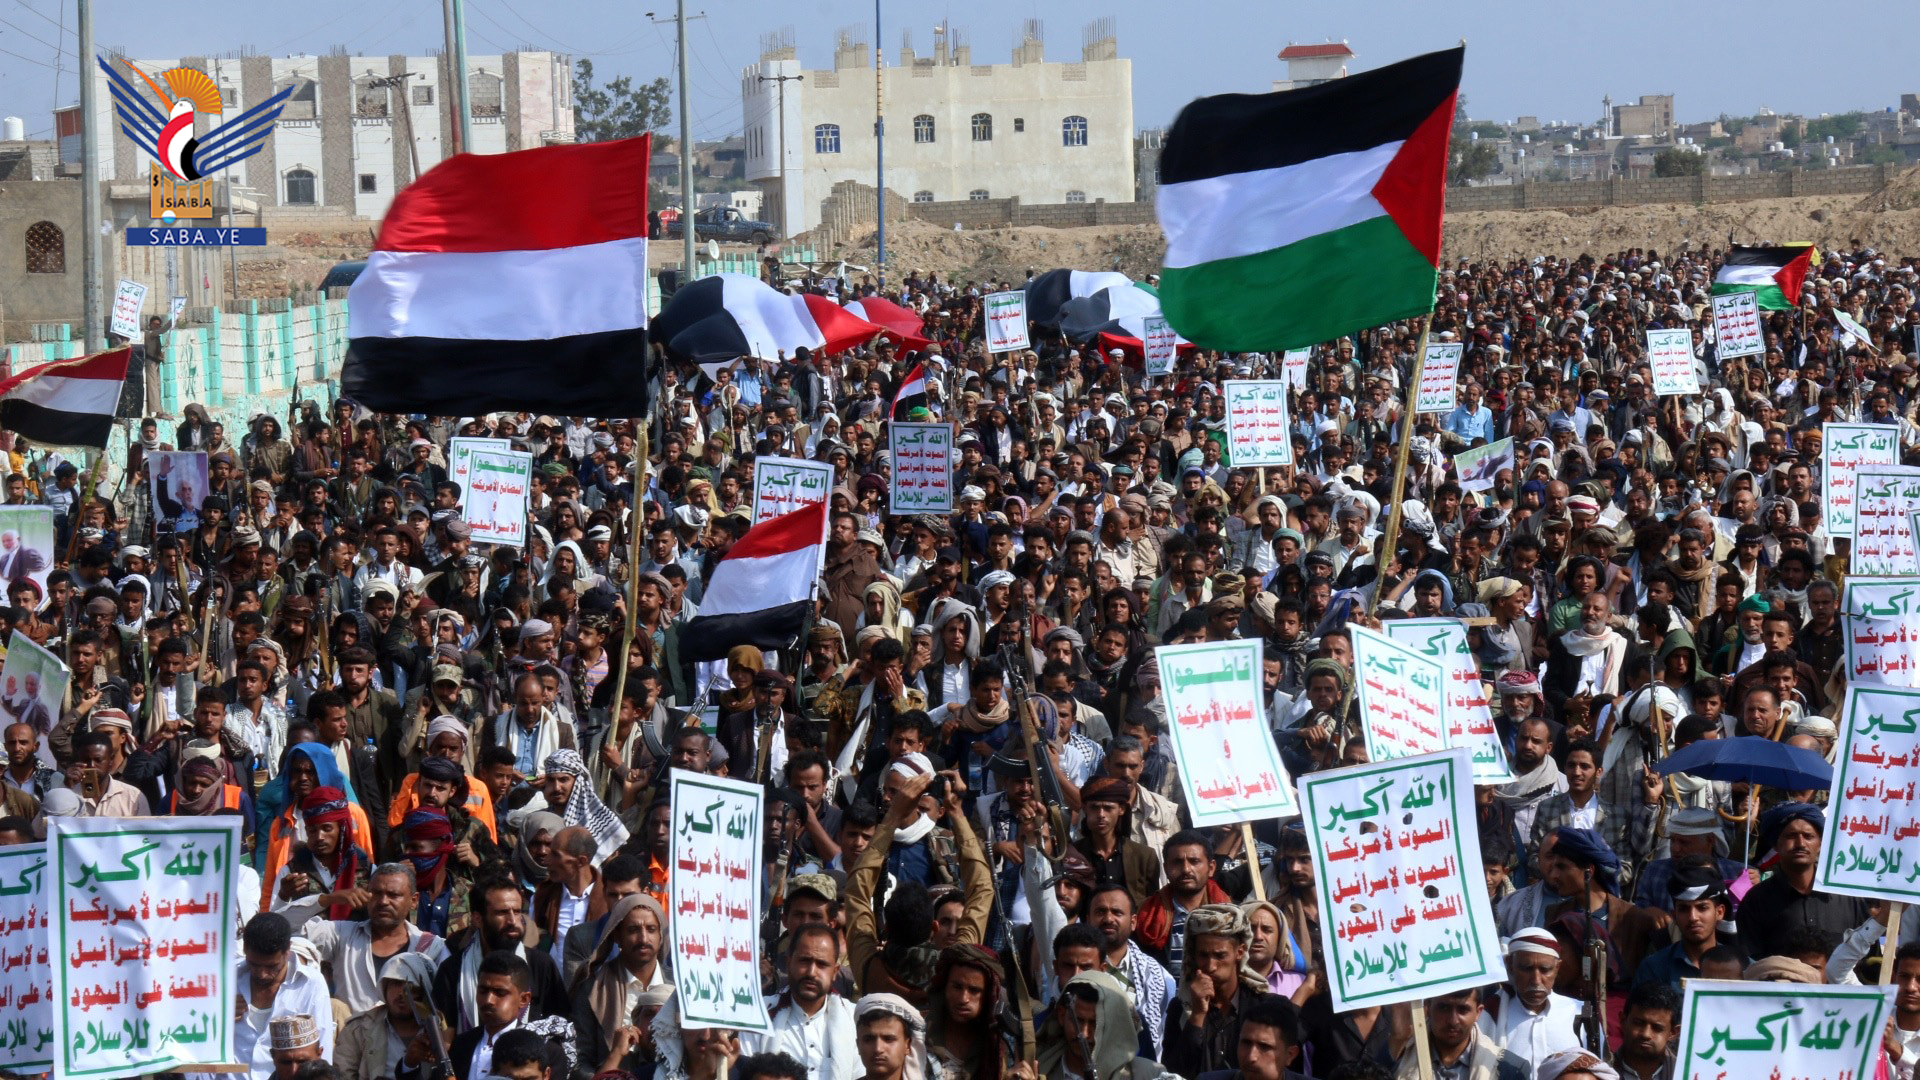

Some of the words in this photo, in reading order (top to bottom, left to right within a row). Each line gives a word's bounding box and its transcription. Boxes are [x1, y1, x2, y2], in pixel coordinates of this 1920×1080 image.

[1717, 296, 1738, 311] أكبر
[1741, 297, 1754, 305] الله
[1233, 386, 1260, 404] أكبر
[1263, 388, 1280, 400] الله
[897, 429, 926, 446] أكبر
[928, 432, 946, 444] الله
[1830, 431, 1868, 454] أكبر
[1870, 434, 1892, 450] الله
[474, 455, 526, 475] قاطعوا
[925, 451, 946, 459] الموت
[761, 469, 800, 489] أكبر
[801, 474, 824, 488] الله
[926, 465, 946, 474] الموت
[897, 491, 922, 506] للإسلام
[925, 491, 948, 505] النصر
[1860, 478, 1901, 502] أكبر
[492, 501, 496, 511] و
[1859, 503, 1895, 518] لأمريكا
[1853, 587, 1914, 624] أكبر
[1854, 623, 1906, 646] لأمريكا
[1168, 655, 1250, 693] قاطعوا
[1364, 654, 1407, 676] أكبر
[1856, 654, 1907, 675] لإسرائيل
[1410, 666, 1438, 692] الله
[1223, 739, 1231, 759] و
[1852, 743, 1920, 769] لأمريكا
[1321, 776, 1395, 834] أكبر
[1401, 773, 1448, 809] الله
[1846, 776, 1915, 806] لإسرائيل
[679, 793, 726, 843] أكبر
[727, 804, 754, 839] الله
[1840, 814, 1889, 838] اليهود
[1325, 824, 1393, 863] لأمريكا
[1398, 818, 1451, 850] الموت
[67, 837, 161, 893] أكبر
[164, 842, 221, 876] الله
[1404, 855, 1456, 887] الموت
[1834, 844, 1903, 882] للإسلام
[1332, 865, 1399, 904] لإسرائيل
[69, 891, 151, 926] لأمريكا
[156, 891, 219, 921] الموت
[1390, 905, 1416, 934] على
[1421, 894, 1463, 922] اللعنة
[1337, 908, 1385, 942] اليهود
[70, 936, 151, 968] لإسرائيل
[156, 930, 217, 962] الموت
[1416, 928, 1472, 974] النصر
[1344, 940, 1408, 988] للإسلام
[16, 982, 39, 1010] على
[71, 978, 128, 1012] اليهود
[135, 979, 163, 1009] على
[168, 973, 216, 999] اللعنة
[73, 1017, 151, 1062] للإسلام
[156, 1008, 217, 1053] النصر
[1695, 1001, 1804, 1066] أكبر
[1799, 1008, 1869, 1050] الله
